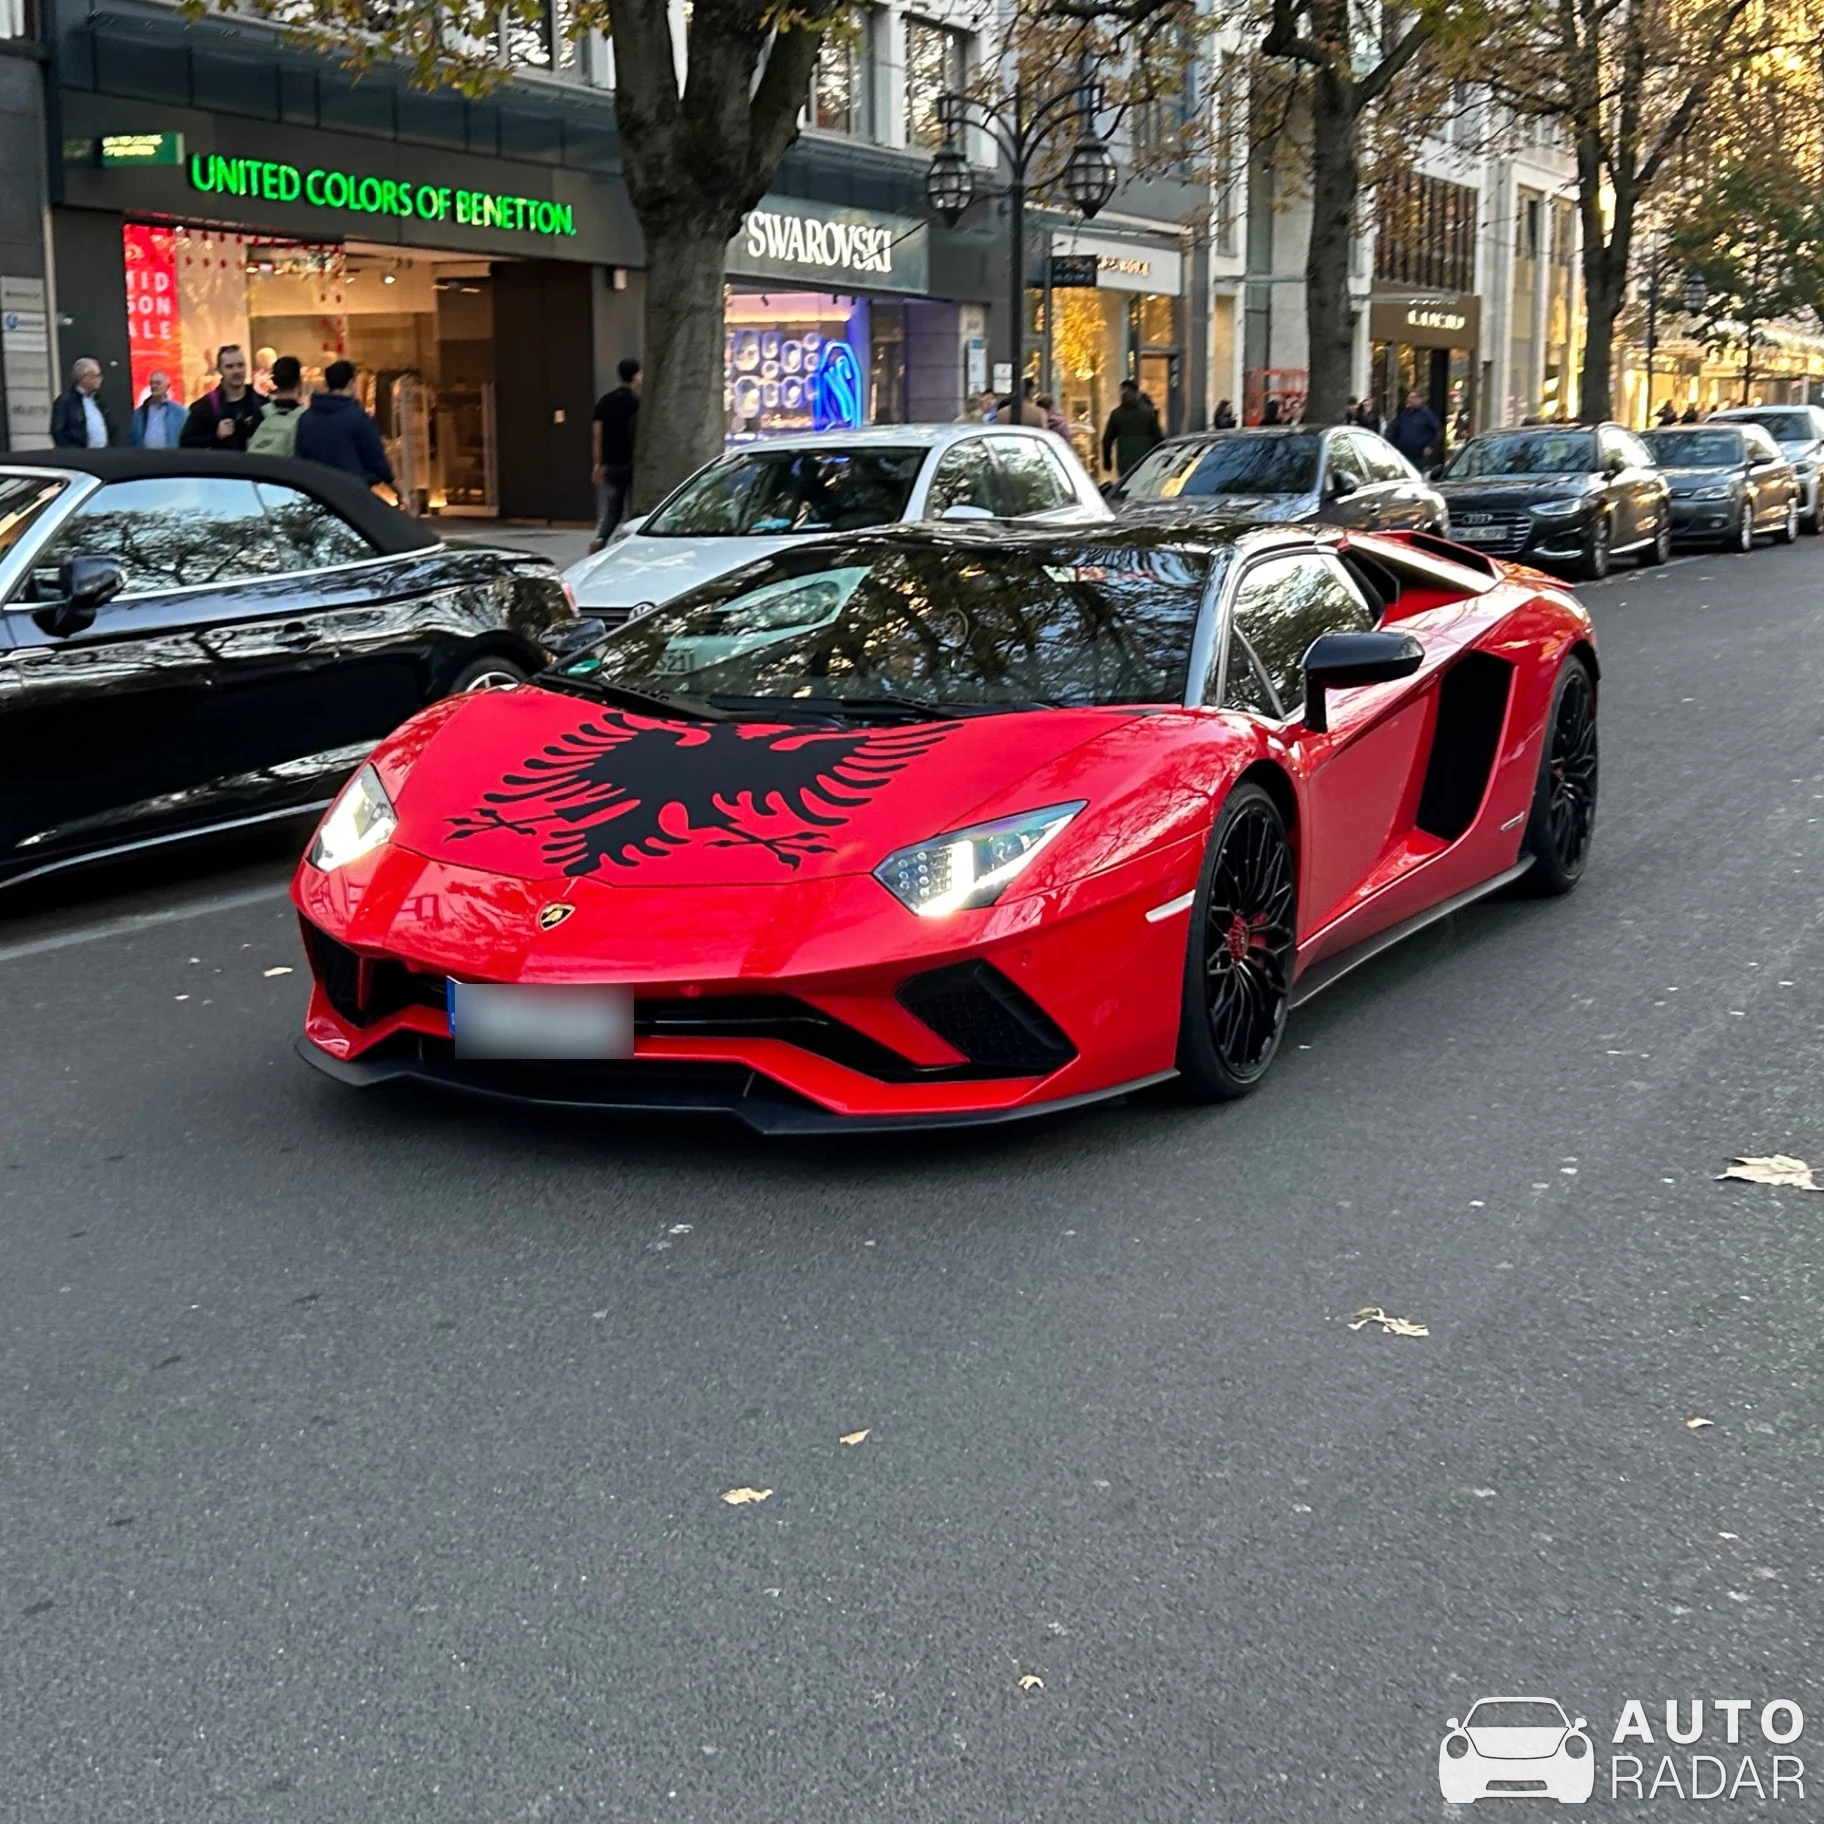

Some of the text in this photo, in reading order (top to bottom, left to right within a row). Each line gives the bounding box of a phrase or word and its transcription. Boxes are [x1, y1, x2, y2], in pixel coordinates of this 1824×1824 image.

[192, 153, 577, 236] UNITED COLORS OF BENETTON.
[747, 210, 893, 273] SWAROVSKI
